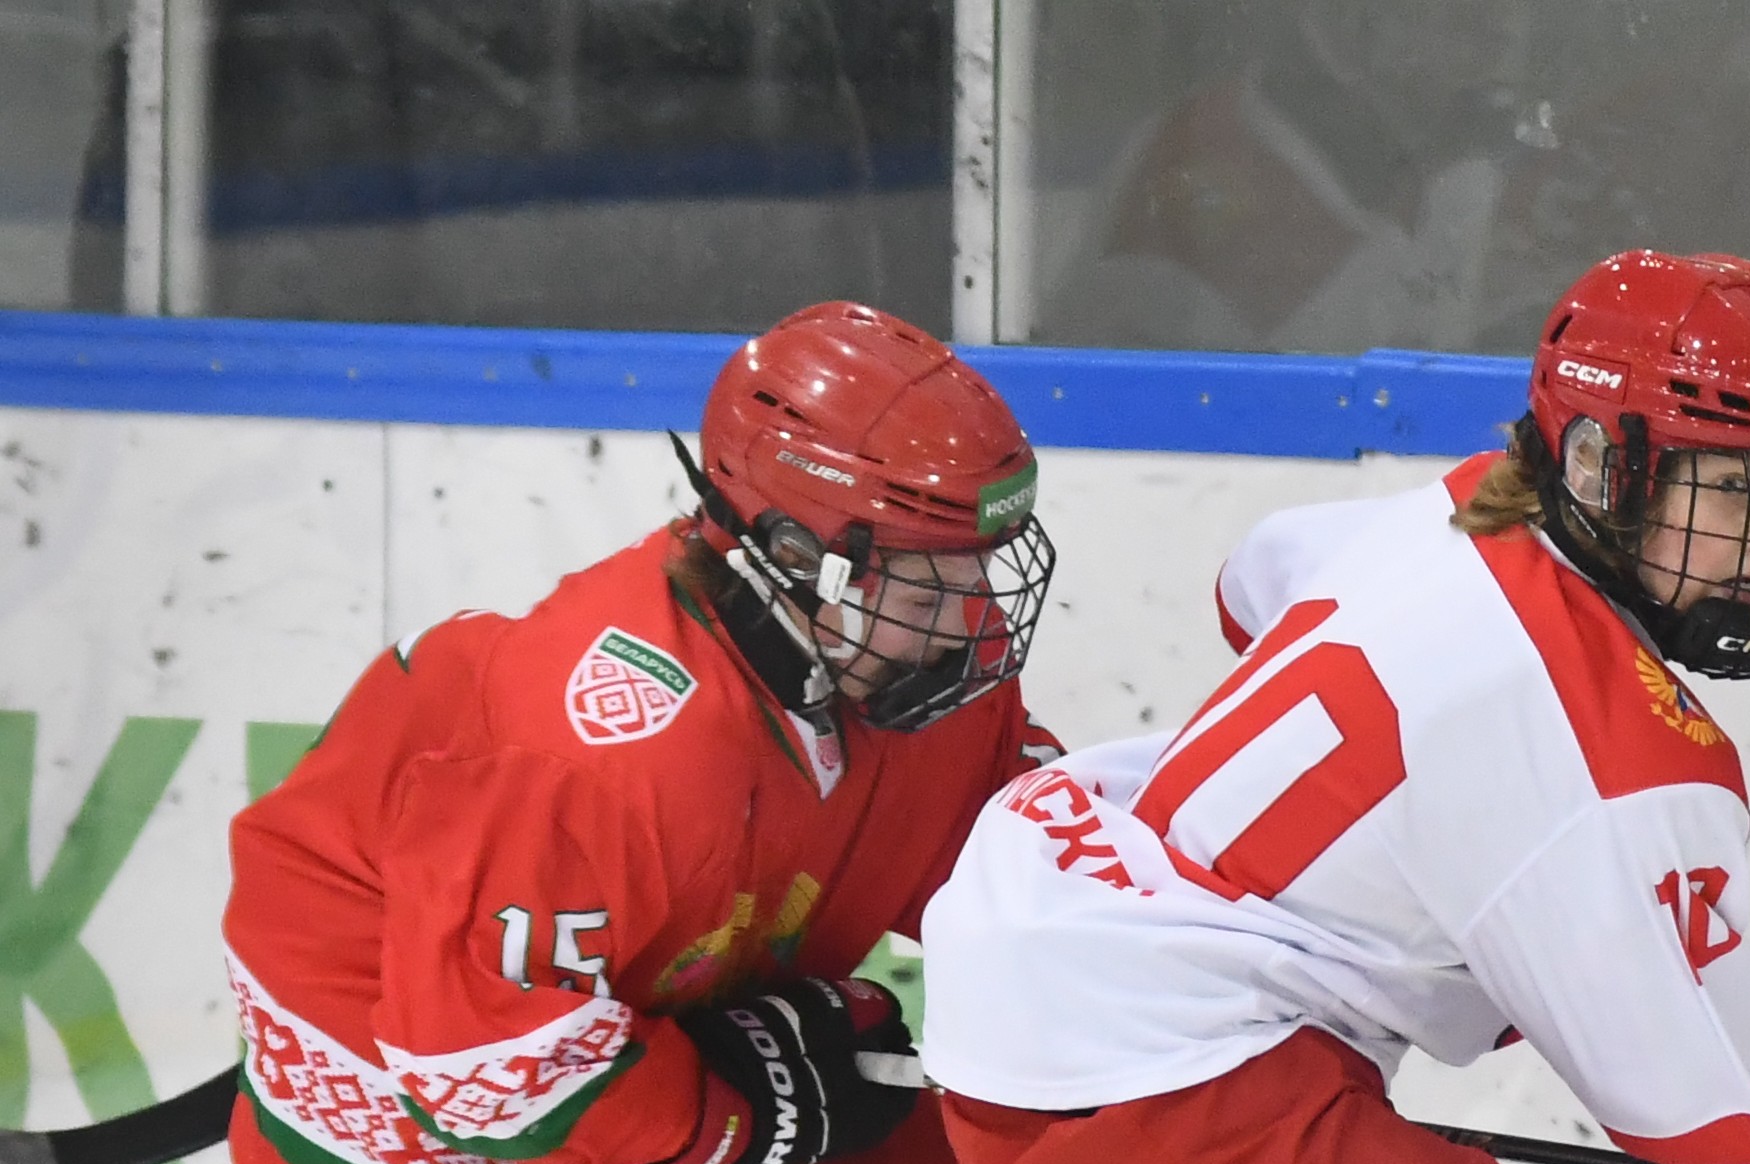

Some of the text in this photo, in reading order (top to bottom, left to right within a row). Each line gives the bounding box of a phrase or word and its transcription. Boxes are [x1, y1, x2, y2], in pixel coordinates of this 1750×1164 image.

[1557, 360, 1623, 390] CCM
[776, 450, 856, 487] BAUER
[604, 637, 686, 690] БЕЛАРУСЬ
[1130, 598, 1408, 903] 10
[494, 904, 613, 998] 15
